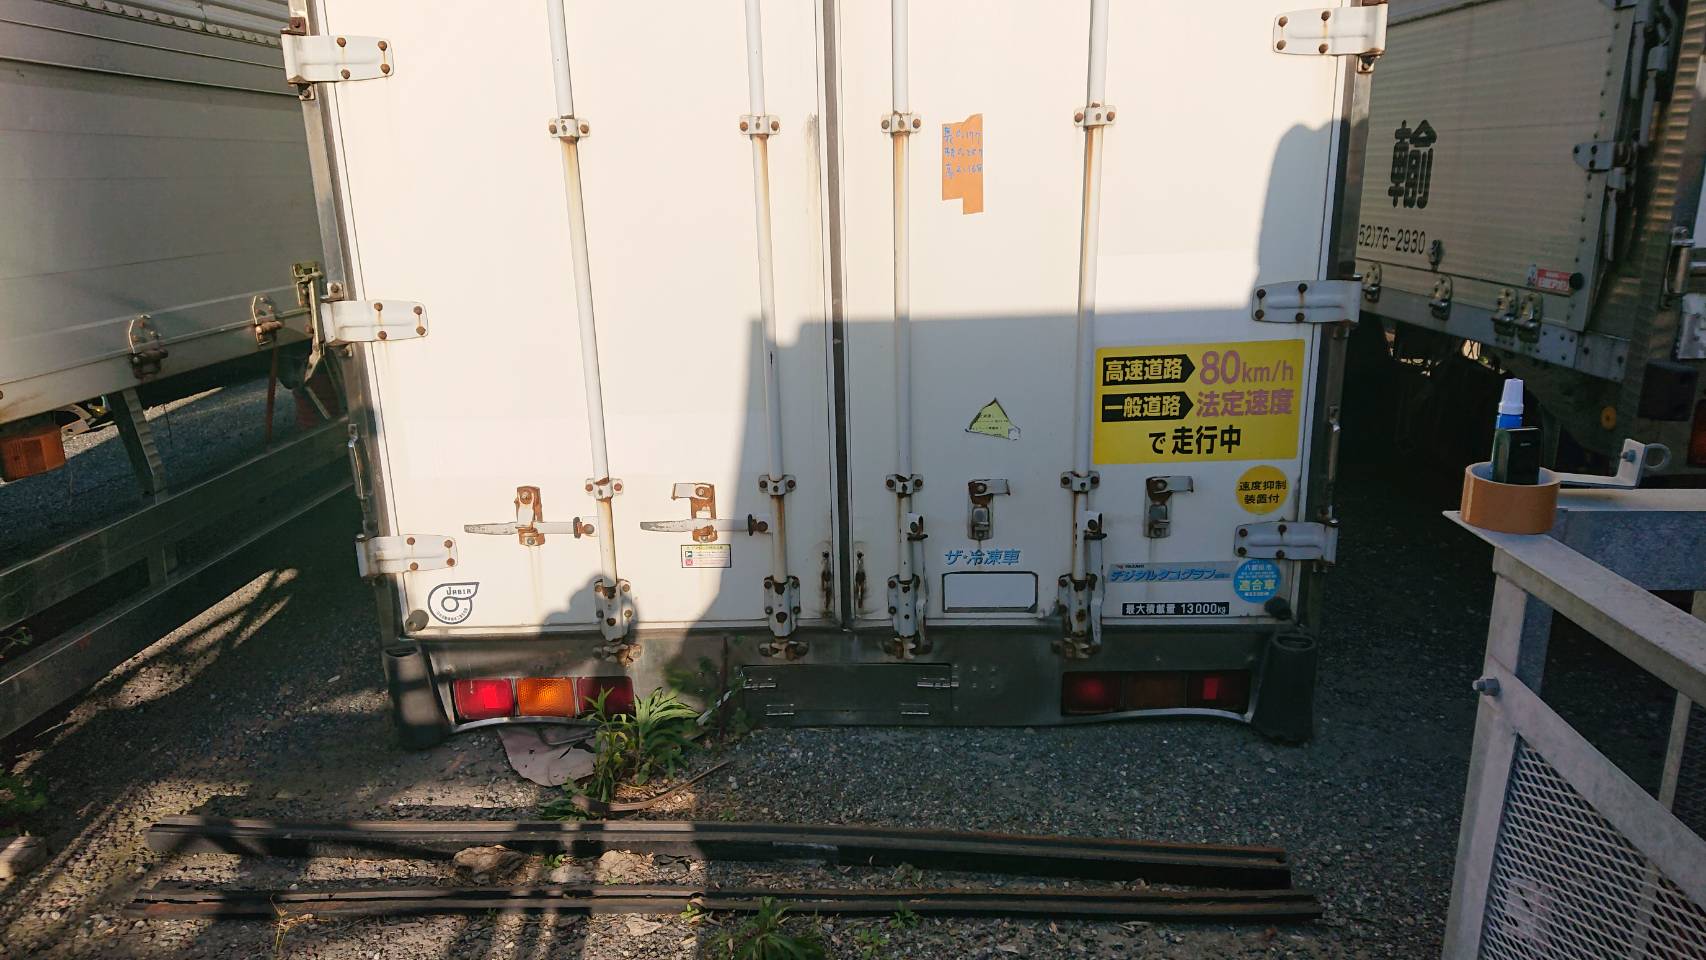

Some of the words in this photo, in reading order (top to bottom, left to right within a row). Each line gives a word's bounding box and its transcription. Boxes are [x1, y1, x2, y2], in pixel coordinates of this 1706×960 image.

[1105, 358, 1183, 382] 高速道路
[1199, 350, 1294, 385] 80km/h
[1104, 396, 1181, 418] 一般道路
[1196, 388, 1294, 418] 法定速度
[1148, 424, 1242, 455] で走行中
[1238, 479, 1287, 492] 速度抑制
[1243, 493, 1280, 505] 装置付
[1238, 578, 1276, 591] 適合車
[1126, 603, 1175, 615] 最大積載量
[1180, 603, 1226, 615] 13000kg
